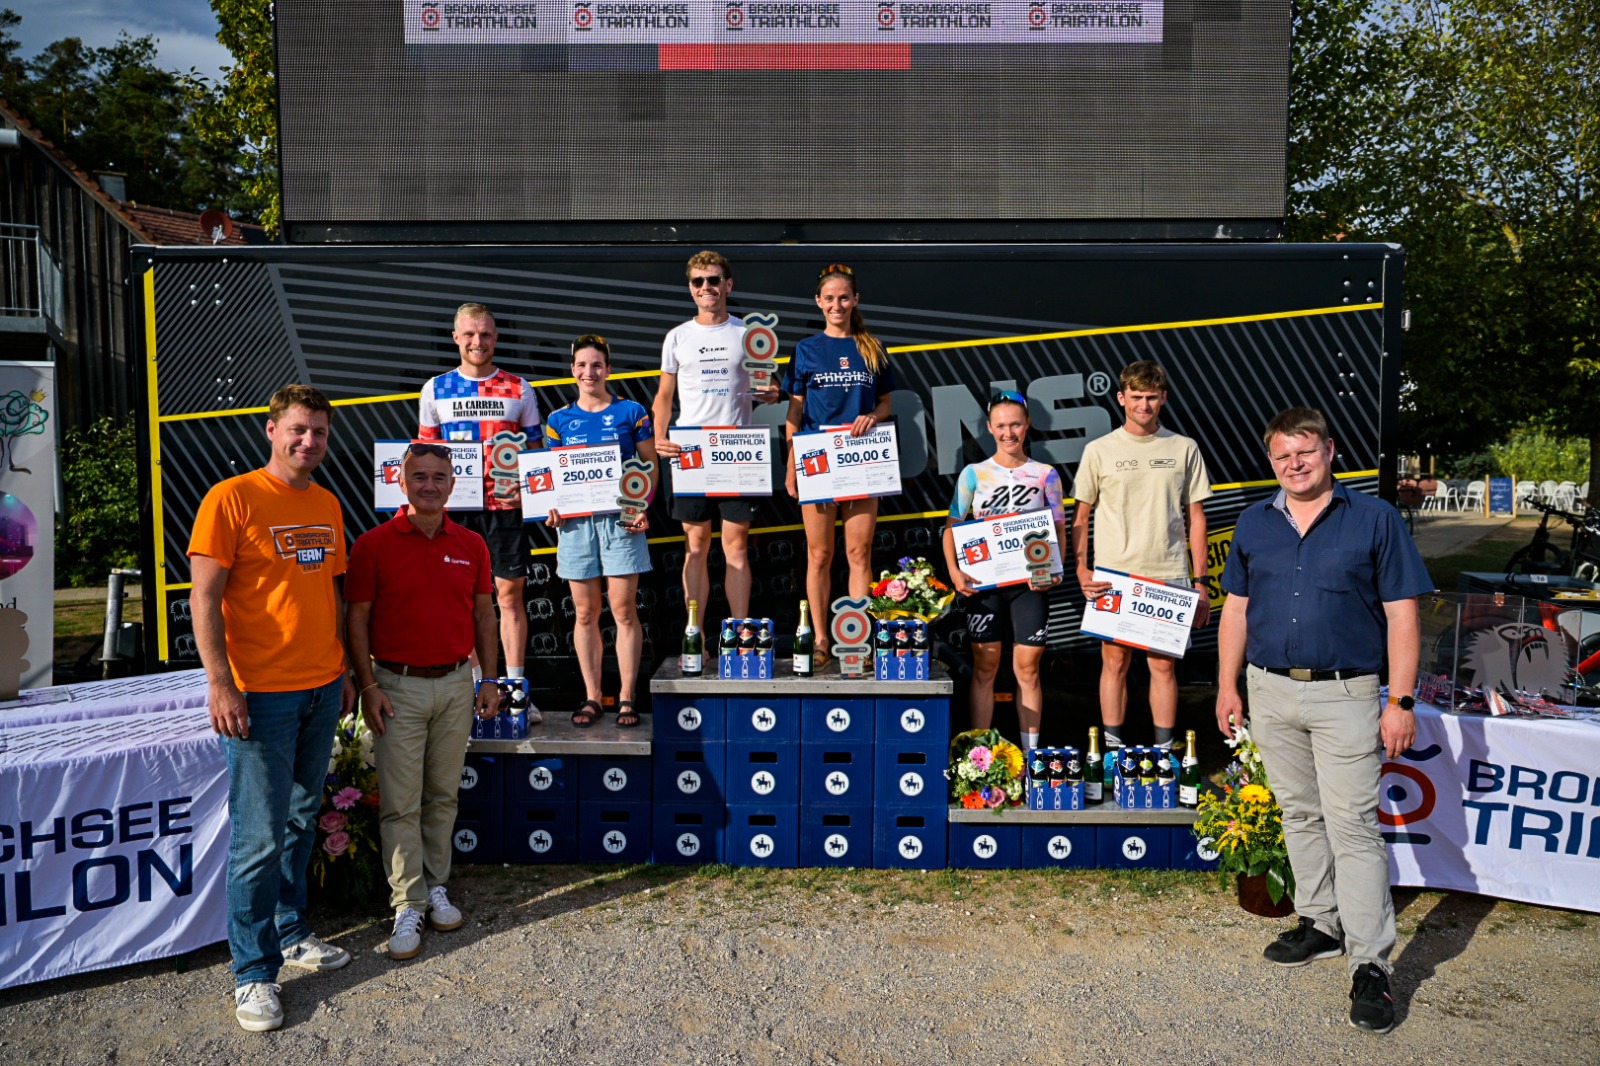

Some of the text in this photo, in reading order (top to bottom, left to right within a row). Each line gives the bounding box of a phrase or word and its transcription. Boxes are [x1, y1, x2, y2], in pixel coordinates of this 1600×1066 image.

[446, 15, 537, 29] TRIATHLON
[598, 15, 689, 29] TRIATHLON
[749, 15, 840, 29] TRIATHLON
[900, 15, 991, 29] TRIATHLON
[1052, 15, 1143, 29] TRIATHLON
[453, 400, 505, 410] LA CARRERA
[845, 436, 892, 447] TRIATHLON
[571, 455, 617, 465] TRIATHLON
[684, 453, 694, 467] 1
[711, 451, 763, 462] 500,00 €
[837, 449, 890, 464] 500,00 €
[1115, 459, 1139, 468] one
[465, 465, 473, 475] €
[809, 457, 820, 473] 1
[390, 466, 401, 482] 2
[563, 468, 614, 482] 250,00 €
[534, 475, 547, 491] 2
[1004, 520, 1050, 534] TRIATHLON
[970, 546, 984, 561] 3
[1102, 595, 1114, 610] 3
[1144, 591, 1192, 608] TRIATHLON
[1131, 601, 1186, 622] 100,00 €
[1467, 759, 1600, 806] BRO
